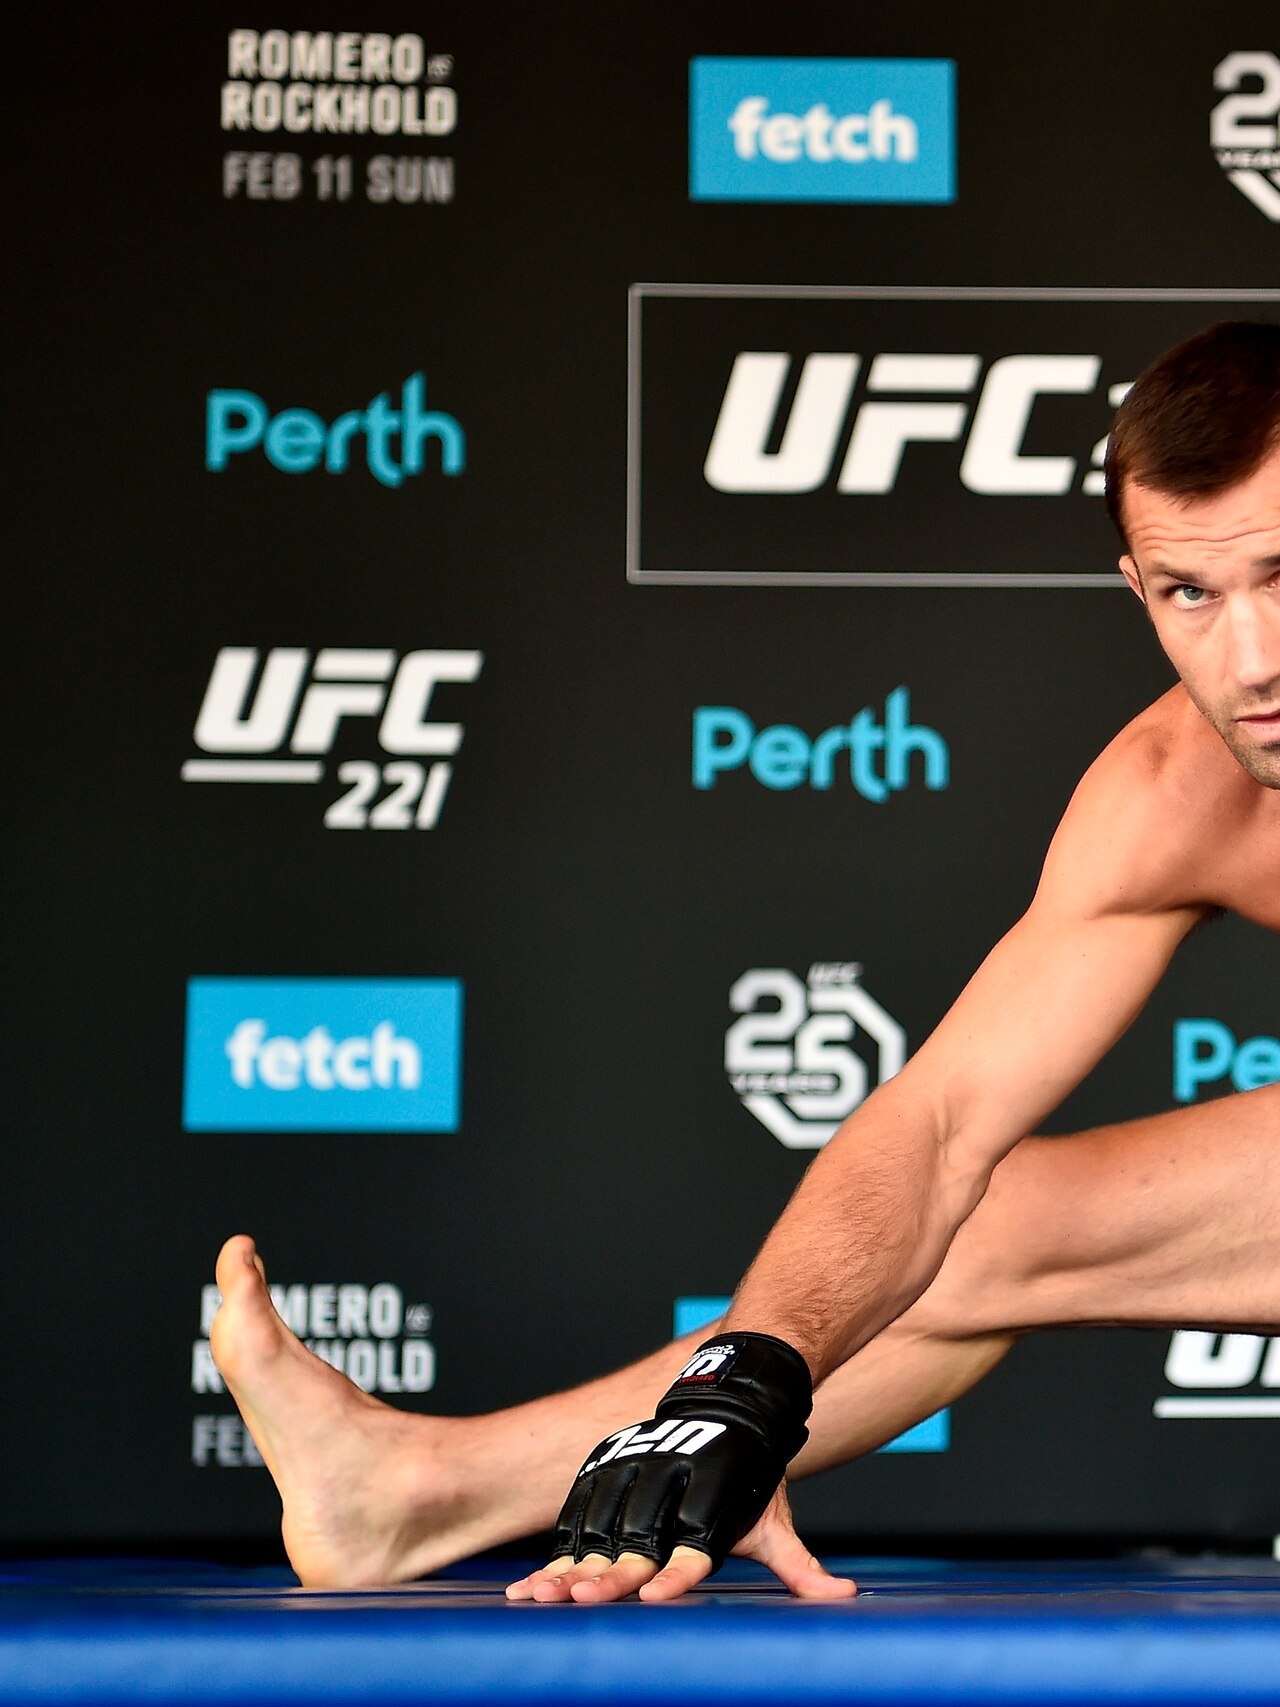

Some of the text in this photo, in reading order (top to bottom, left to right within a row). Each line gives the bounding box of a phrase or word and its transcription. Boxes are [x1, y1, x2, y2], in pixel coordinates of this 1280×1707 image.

[228, 29, 424, 84] ROMERO
[221, 81, 458, 136] ROCKHOLD
[728, 95, 918, 163] fetch
[223, 151, 454, 205] FEB 11 SUN
[206, 371, 466, 489] Perth
[704, 351, 1102, 496] UFC
[193, 646, 484, 756] UFC
[692, 684, 949, 805] Perth
[323, 760, 452, 831] 221
[225, 1017, 421, 1091] fetch
[724, 967, 909, 1149] 25
[201, 1283, 404, 1339] RMERO
[192, 1339, 436, 1393] ROLD
